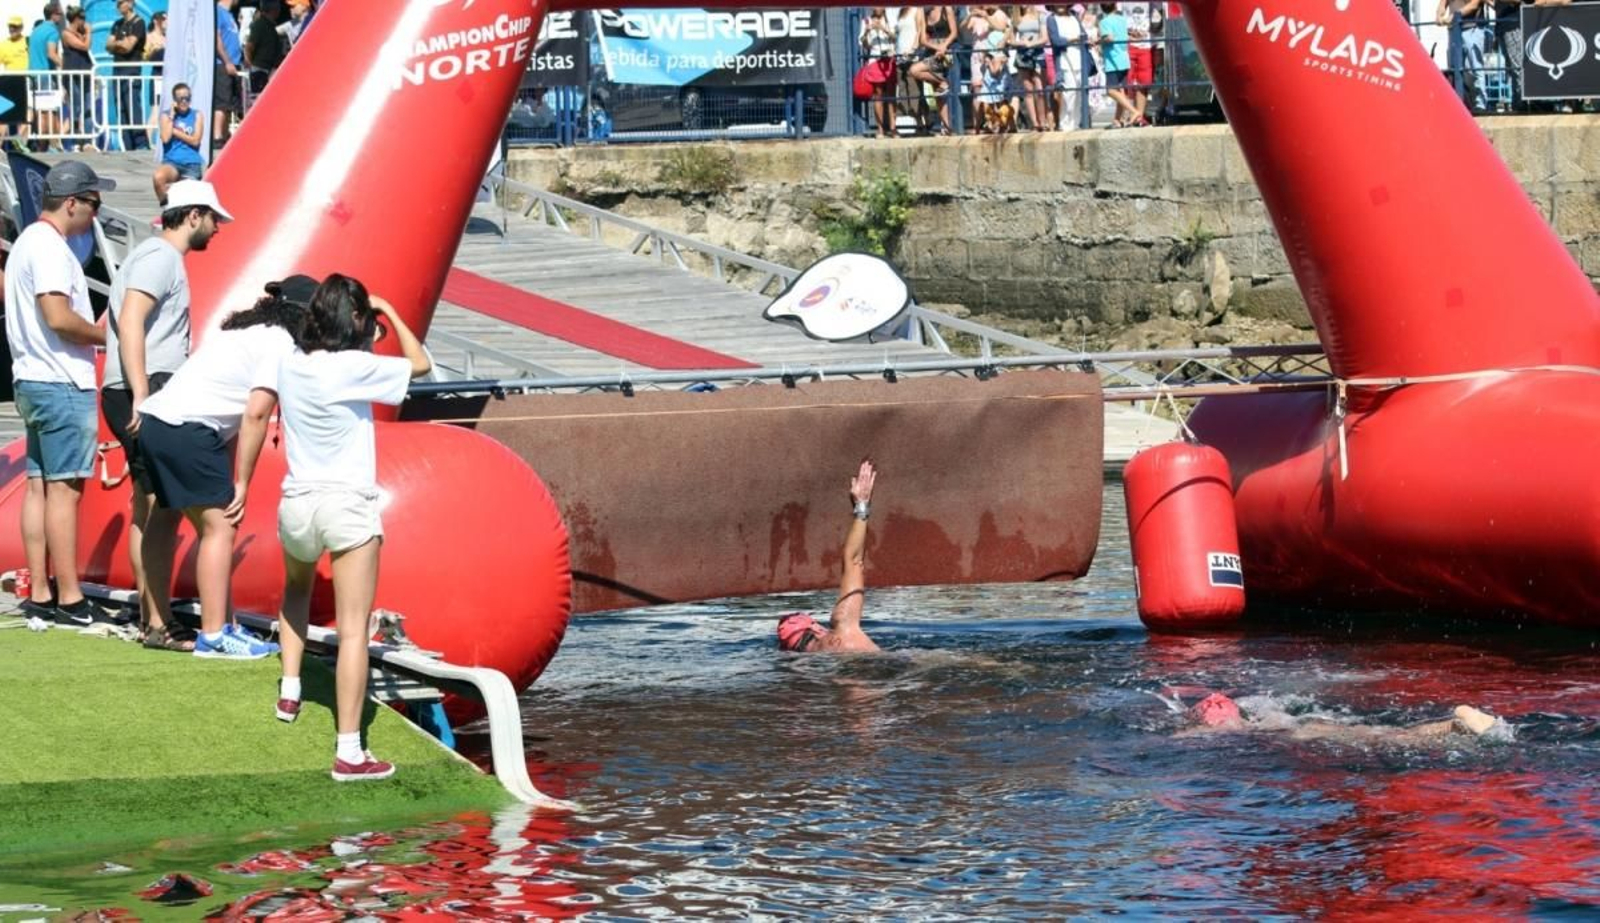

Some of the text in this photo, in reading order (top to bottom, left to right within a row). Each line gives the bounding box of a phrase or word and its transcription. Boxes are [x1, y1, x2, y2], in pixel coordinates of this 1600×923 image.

[608, 47, 816, 74] ebida para deportistas
[1246, 7, 1405, 79] MYLAPS
[391, 37, 530, 91] NORTE
[526, 52, 574, 71] istas
[1303, 57, 1402, 92] SPORTS TIMING
